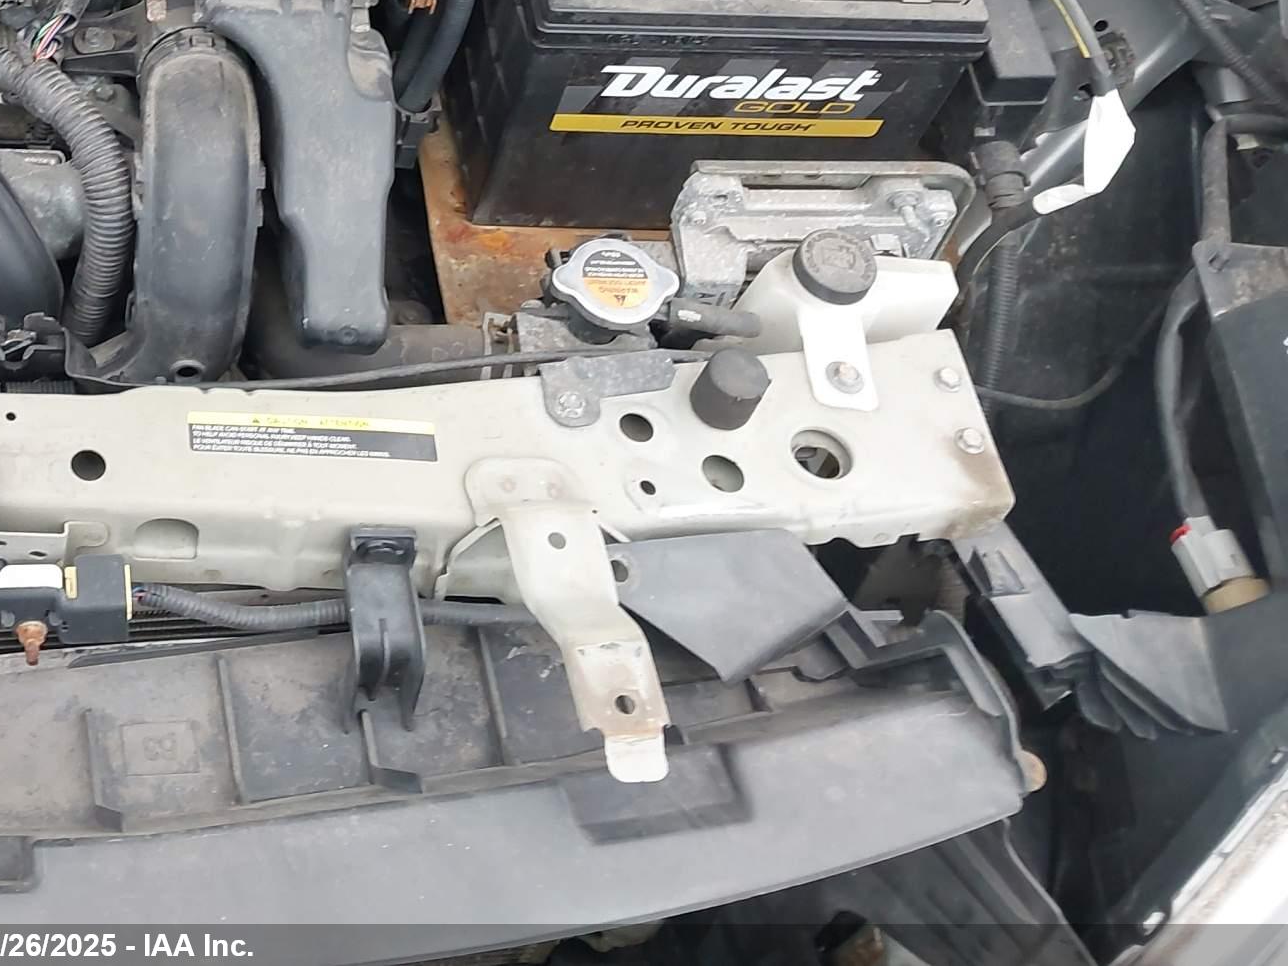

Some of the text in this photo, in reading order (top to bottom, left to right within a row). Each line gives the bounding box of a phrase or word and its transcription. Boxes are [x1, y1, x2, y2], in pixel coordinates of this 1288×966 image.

[600, 64, 880, 102] Duralast
[734, 101, 857, 115] GOLD
[620, 120, 813, 133] PROVEN TOUGH
